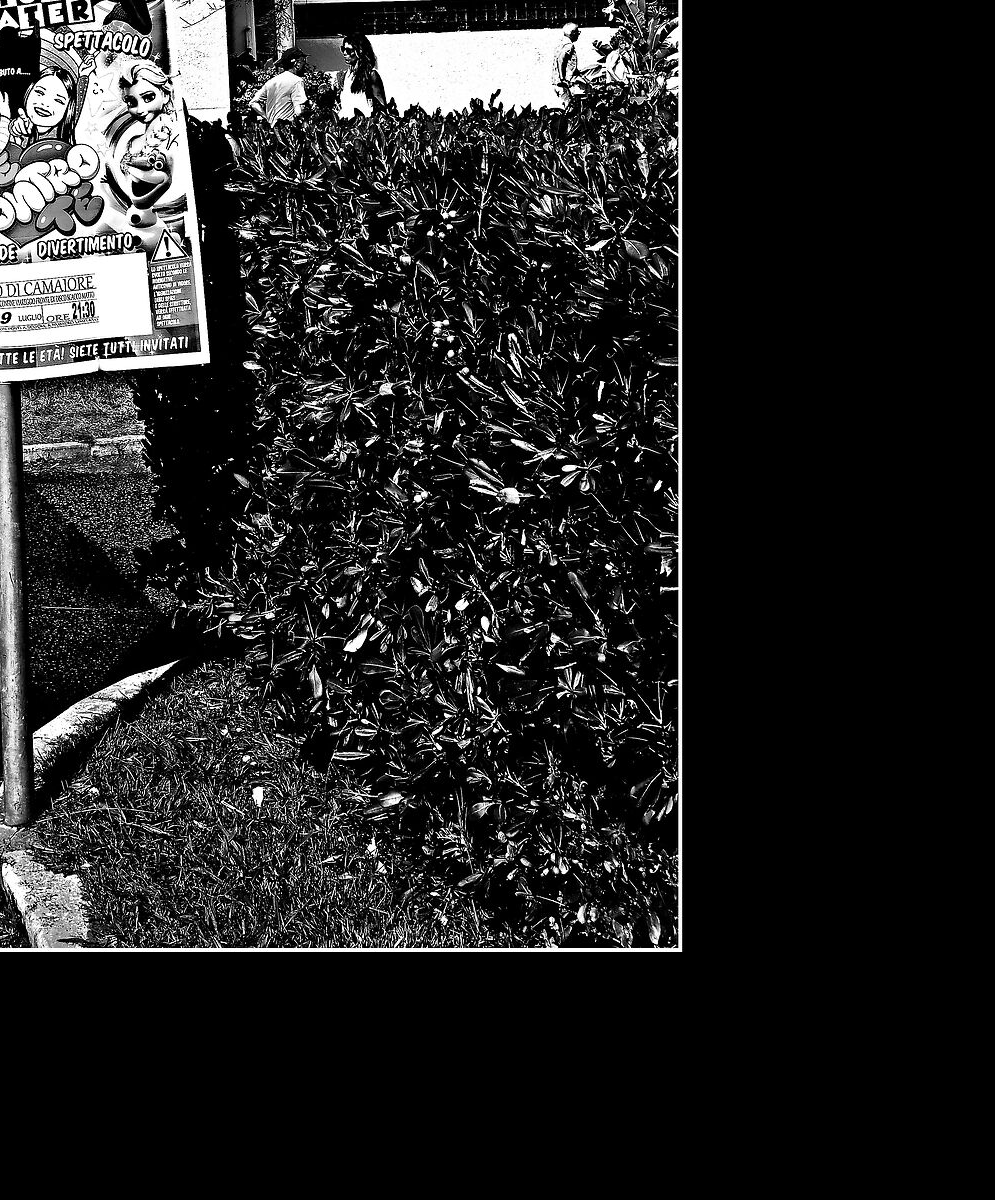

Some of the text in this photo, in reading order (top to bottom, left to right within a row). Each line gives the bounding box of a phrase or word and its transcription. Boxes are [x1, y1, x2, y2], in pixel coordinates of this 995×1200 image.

[54, 31, 151, 58] SPETTACOLO
[38, 233, 133, 258] DIVERTIMENTO
[6, 283, 21, 297] DI
[24, 275, 93, 295] CAMAIORE
[18, 313, 42, 322] LUGLIO
[46, 313, 69, 322] ORE
[72, 301, 95, 319] 21:30
[23, 350, 35, 364] LE
[40, 344, 65, 362] ETÀ!
[69, 342, 99, 359] SIETE
[105, 339, 136, 356] TUTTI
[140, 335, 189, 353] INVITATI
